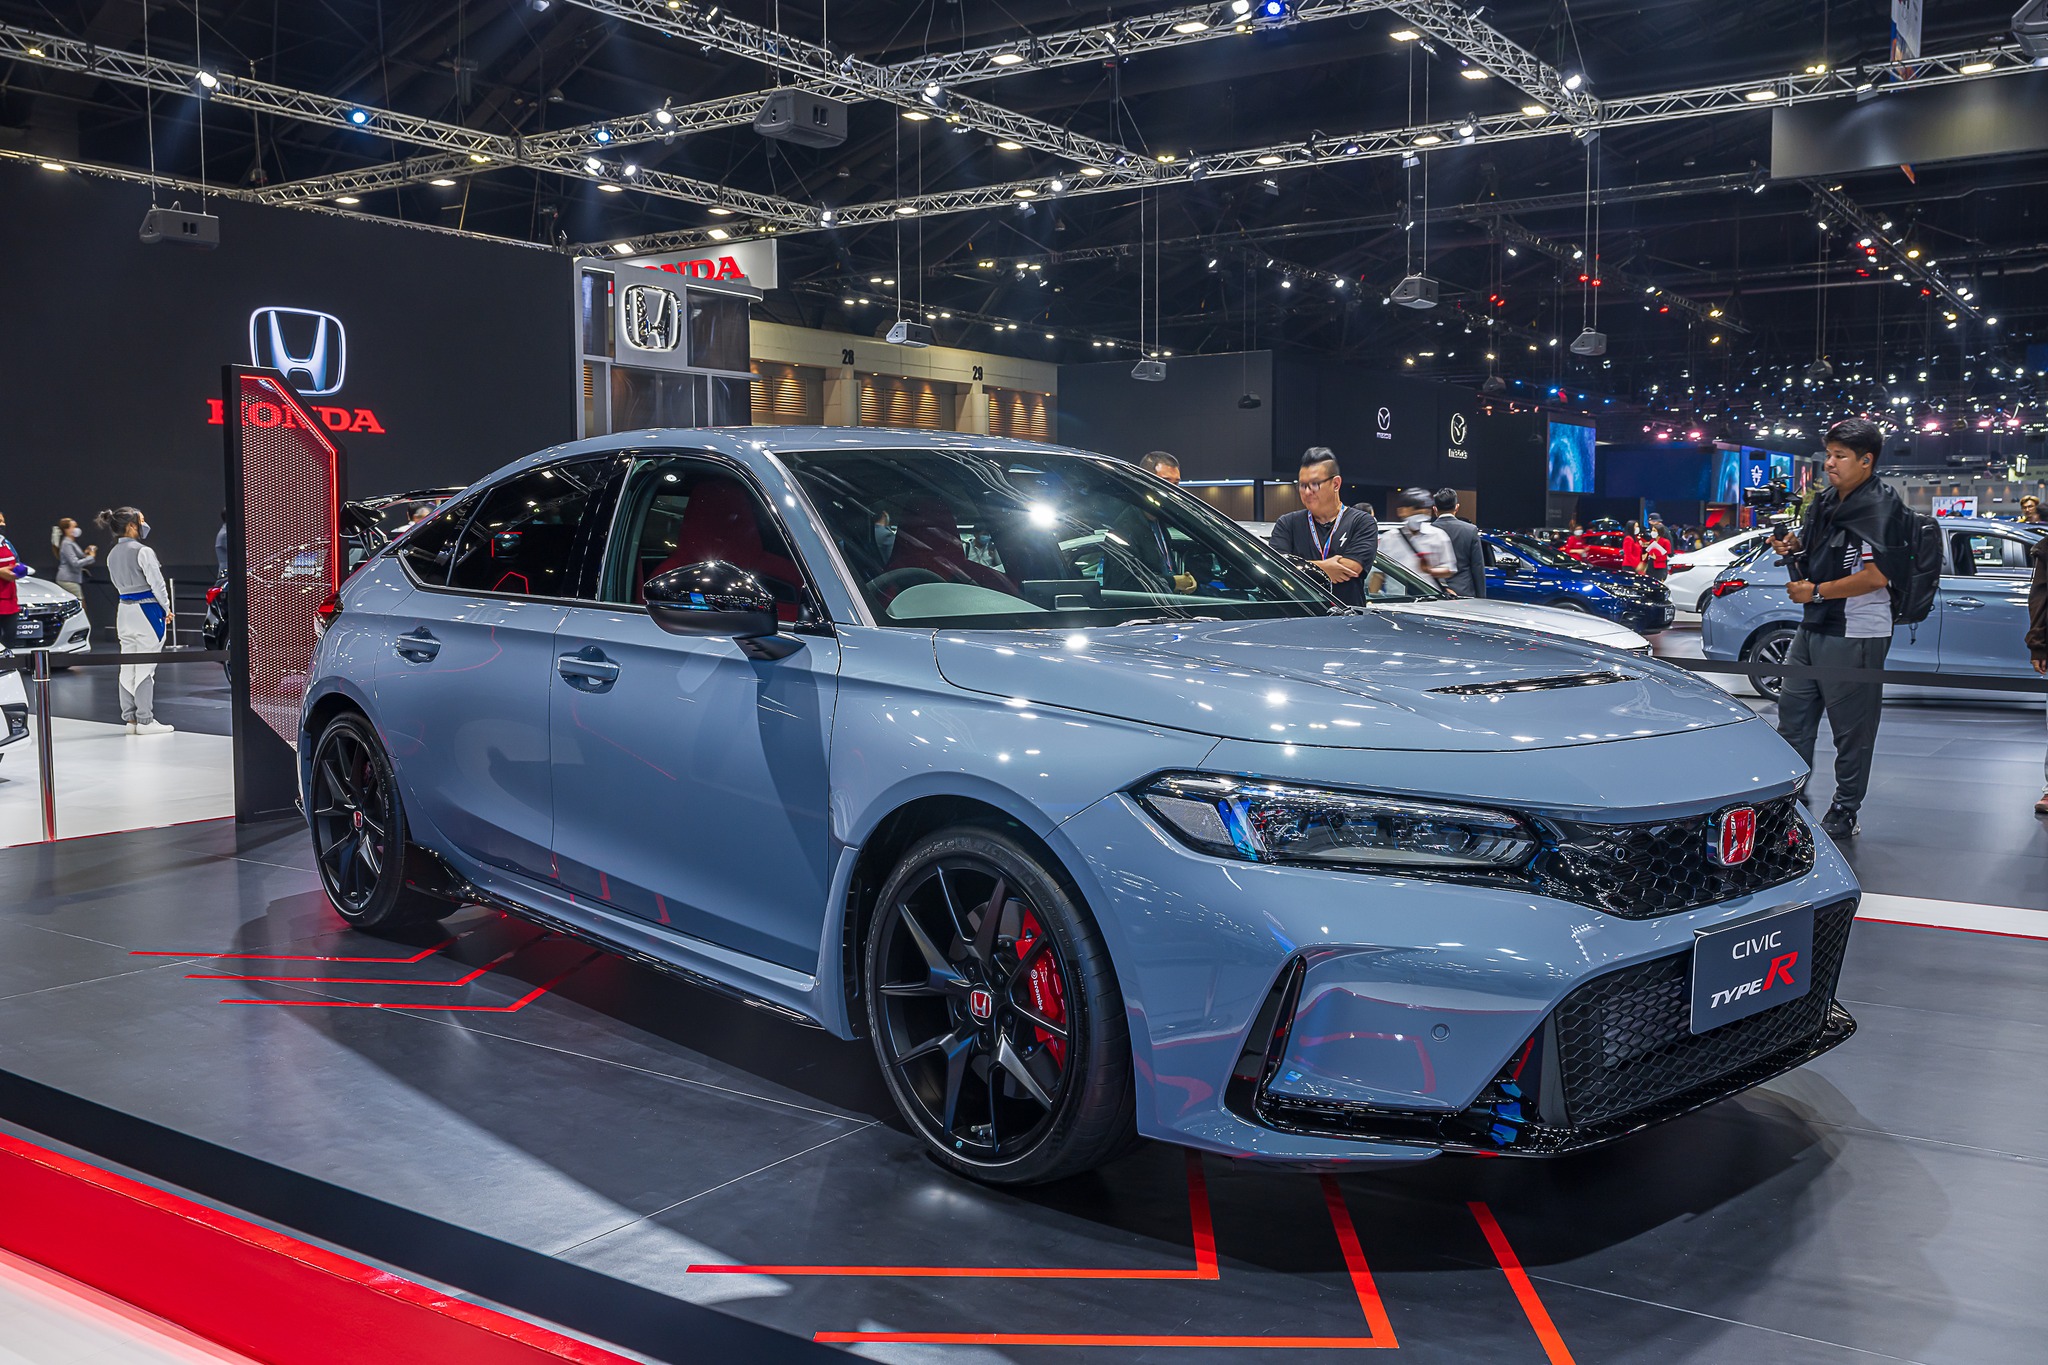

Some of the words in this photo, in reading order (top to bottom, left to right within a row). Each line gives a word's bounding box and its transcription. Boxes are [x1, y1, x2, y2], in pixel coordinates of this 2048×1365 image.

[642, 255, 745, 282] NDA
[842, 349, 855, 365] 28
[972, 365, 984, 381] 29
[1732, 930, 1782, 960] CIVIC
[1710, 978, 1764, 1009] TYPE
[1762, 951, 1799, 992] R
[1033, 979, 1044, 1011] brembo
